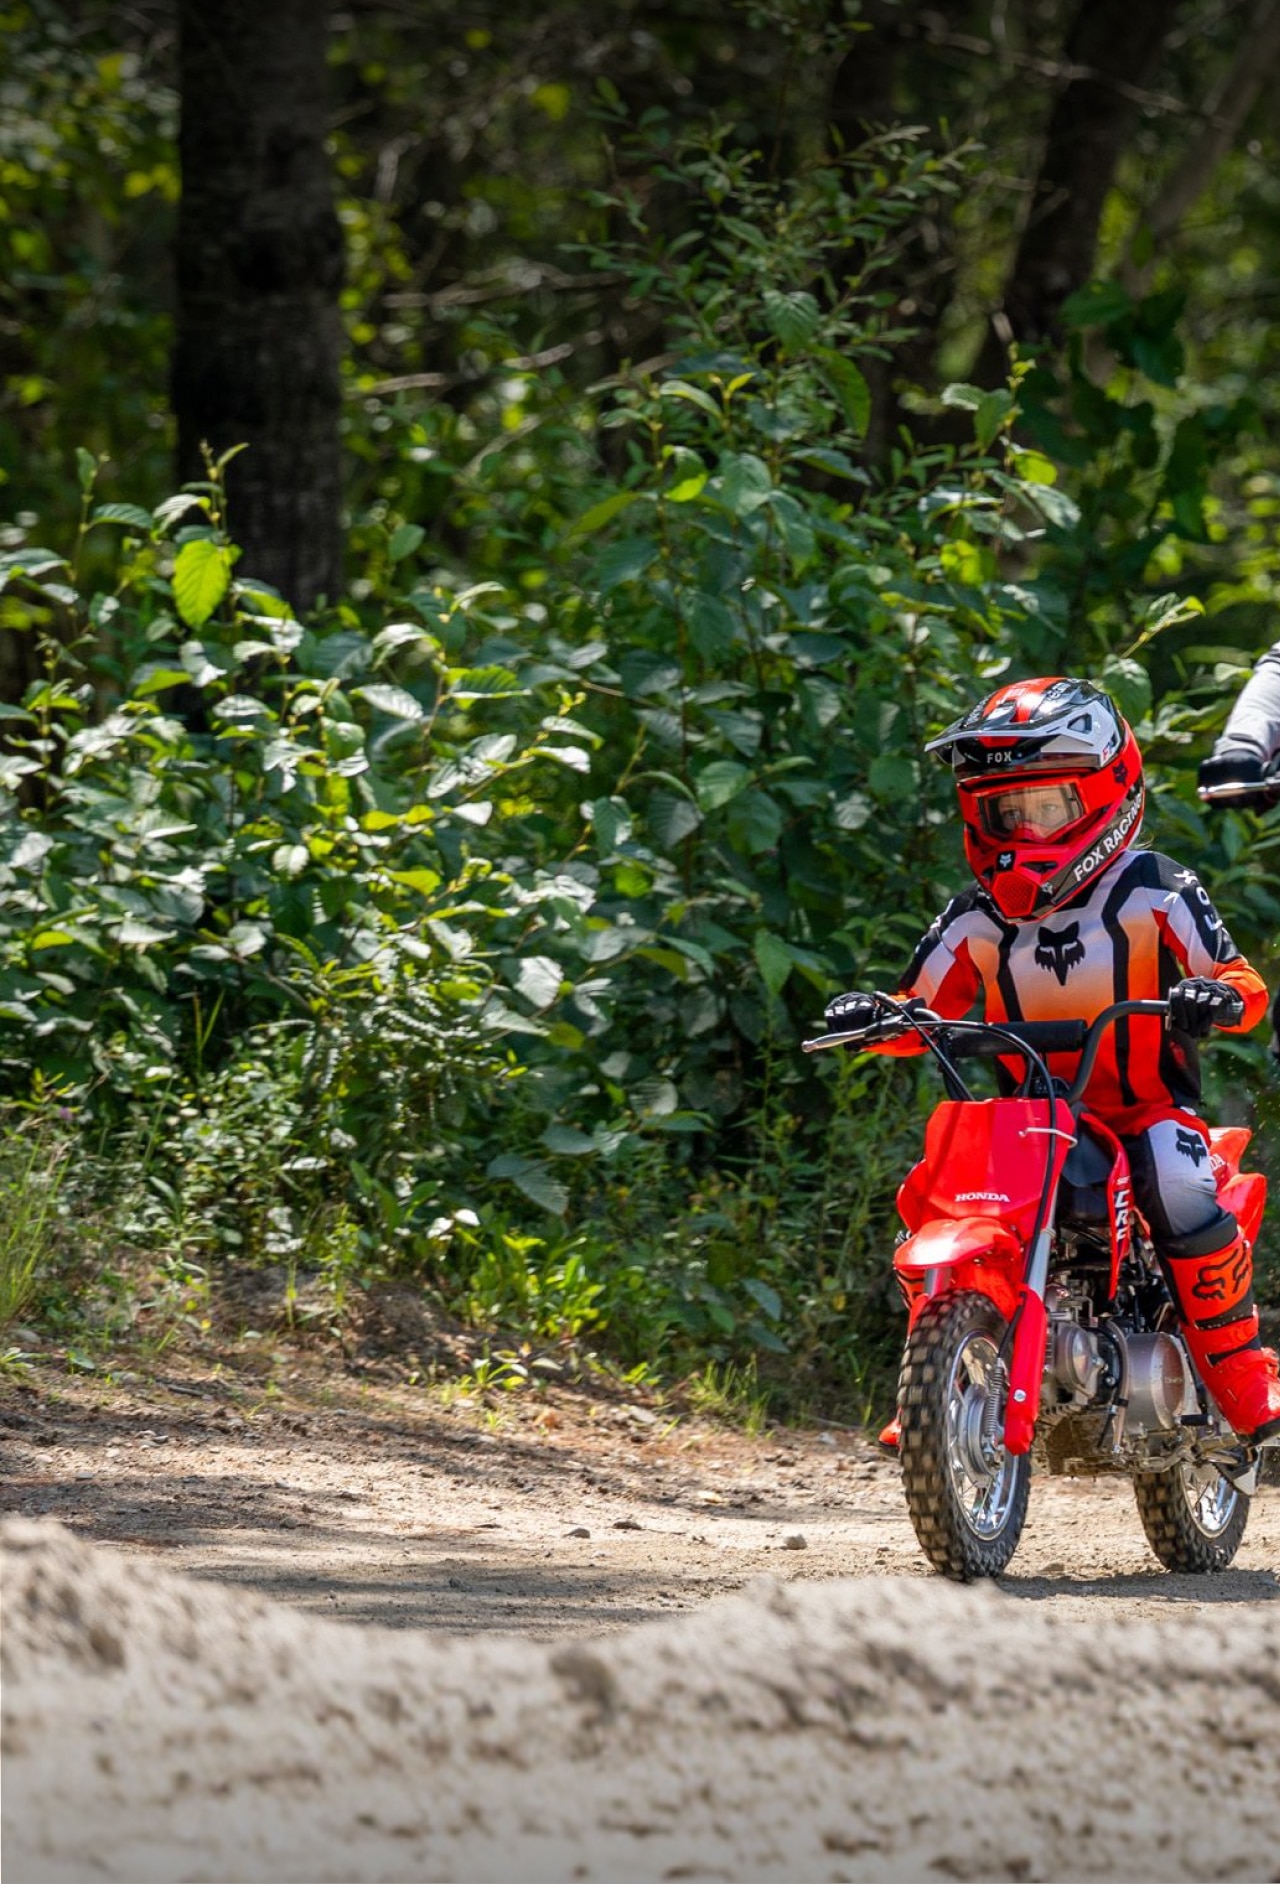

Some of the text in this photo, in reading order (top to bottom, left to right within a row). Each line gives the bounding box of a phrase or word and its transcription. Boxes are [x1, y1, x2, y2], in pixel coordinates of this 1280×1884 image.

[986, 751, 1012, 764] FOX
[1073, 849, 1104, 882] FOX
[955, 1191, 1010, 1202] HONDA
